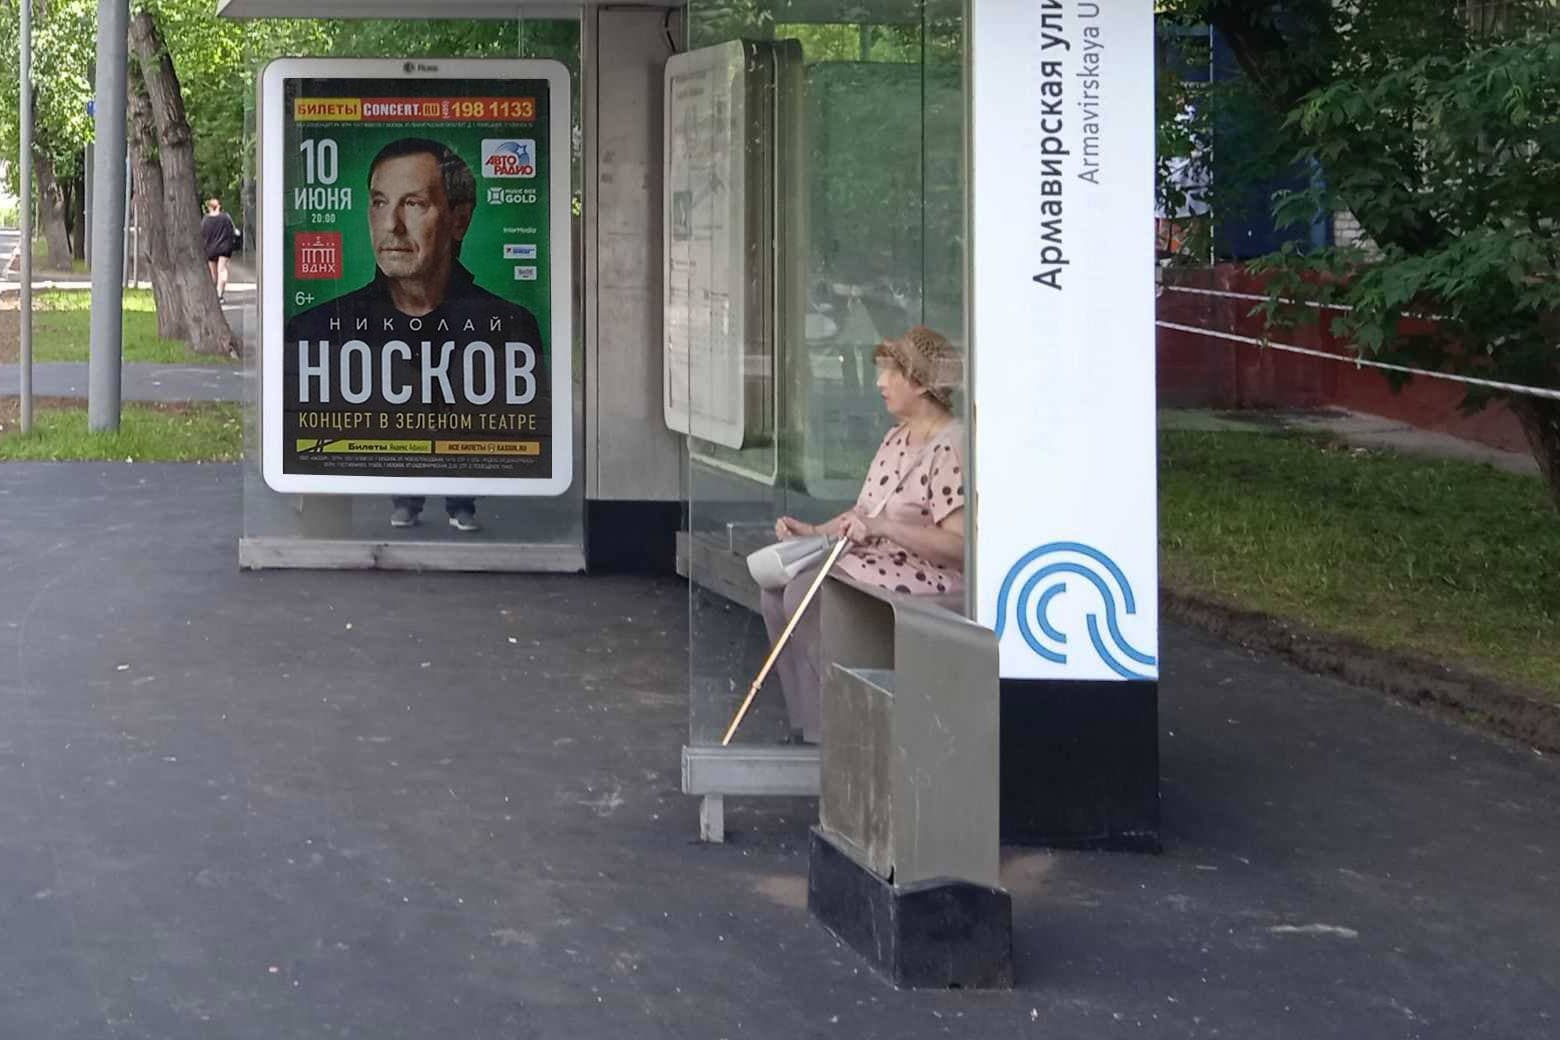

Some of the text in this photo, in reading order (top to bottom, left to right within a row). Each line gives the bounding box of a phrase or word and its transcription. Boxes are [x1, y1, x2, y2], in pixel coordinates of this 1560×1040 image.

[297, 103, 357, 115] БИЛЕТЫ
[451, 101, 533, 117] 198 1133
[1076, 26, 1105, 185] Armavirskaya
[300, 138, 338, 185] 10
[494, 165, 533, 175] РАДИО
[1032, 61, 1070, 290] Армавирская
[294, 187, 352, 210] ИЮНЯ
[505, 194, 537, 204] GOLD
[302, 263, 336, 273] ВДНХ
[295, 291, 315, 306] 6+
[329, 316, 502, 332] НИКОЛАЙ
[298, 340, 537, 405] НОСКОВ
[299, 412, 537, 431] КОНЦЕРТ В ЗЕЛЕНОМ ТЕАТРЕ
[348, 442, 388, 451] Билеты
